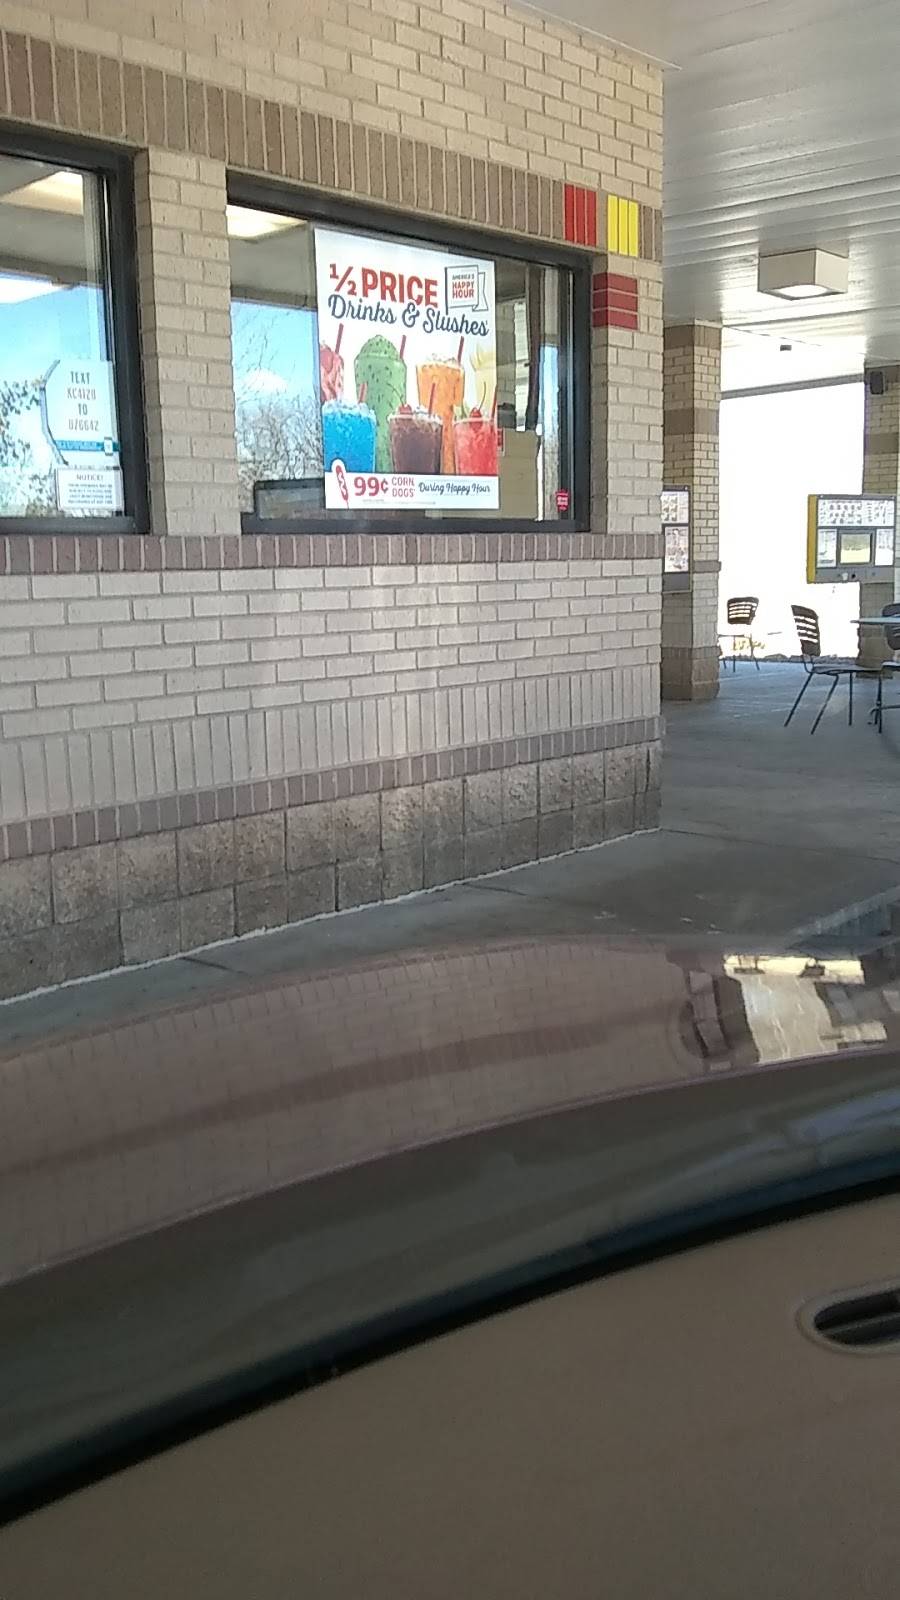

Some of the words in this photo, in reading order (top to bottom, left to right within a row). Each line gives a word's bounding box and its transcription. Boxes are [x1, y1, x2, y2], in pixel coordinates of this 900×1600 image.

[361, 267, 439, 309] PRICE
[452, 281, 475, 289] HAPPY
[452, 289, 475, 299] HOUR
[328, 294, 397, 324] Drinks
[401, 302, 420, 328] &
[423, 308, 489, 337] Slushes
[70, 371, 90, 385] TEXT
[78, 402, 88, 416] TO
[353, 476, 389, 496] 99¢
[391, 476, 415, 487] CORN
[391, 488, 414, 498] DOGS
[418, 482, 445, 496] During
[445, 482, 470, 496] Happy
[471, 482, 491, 493] Hour
